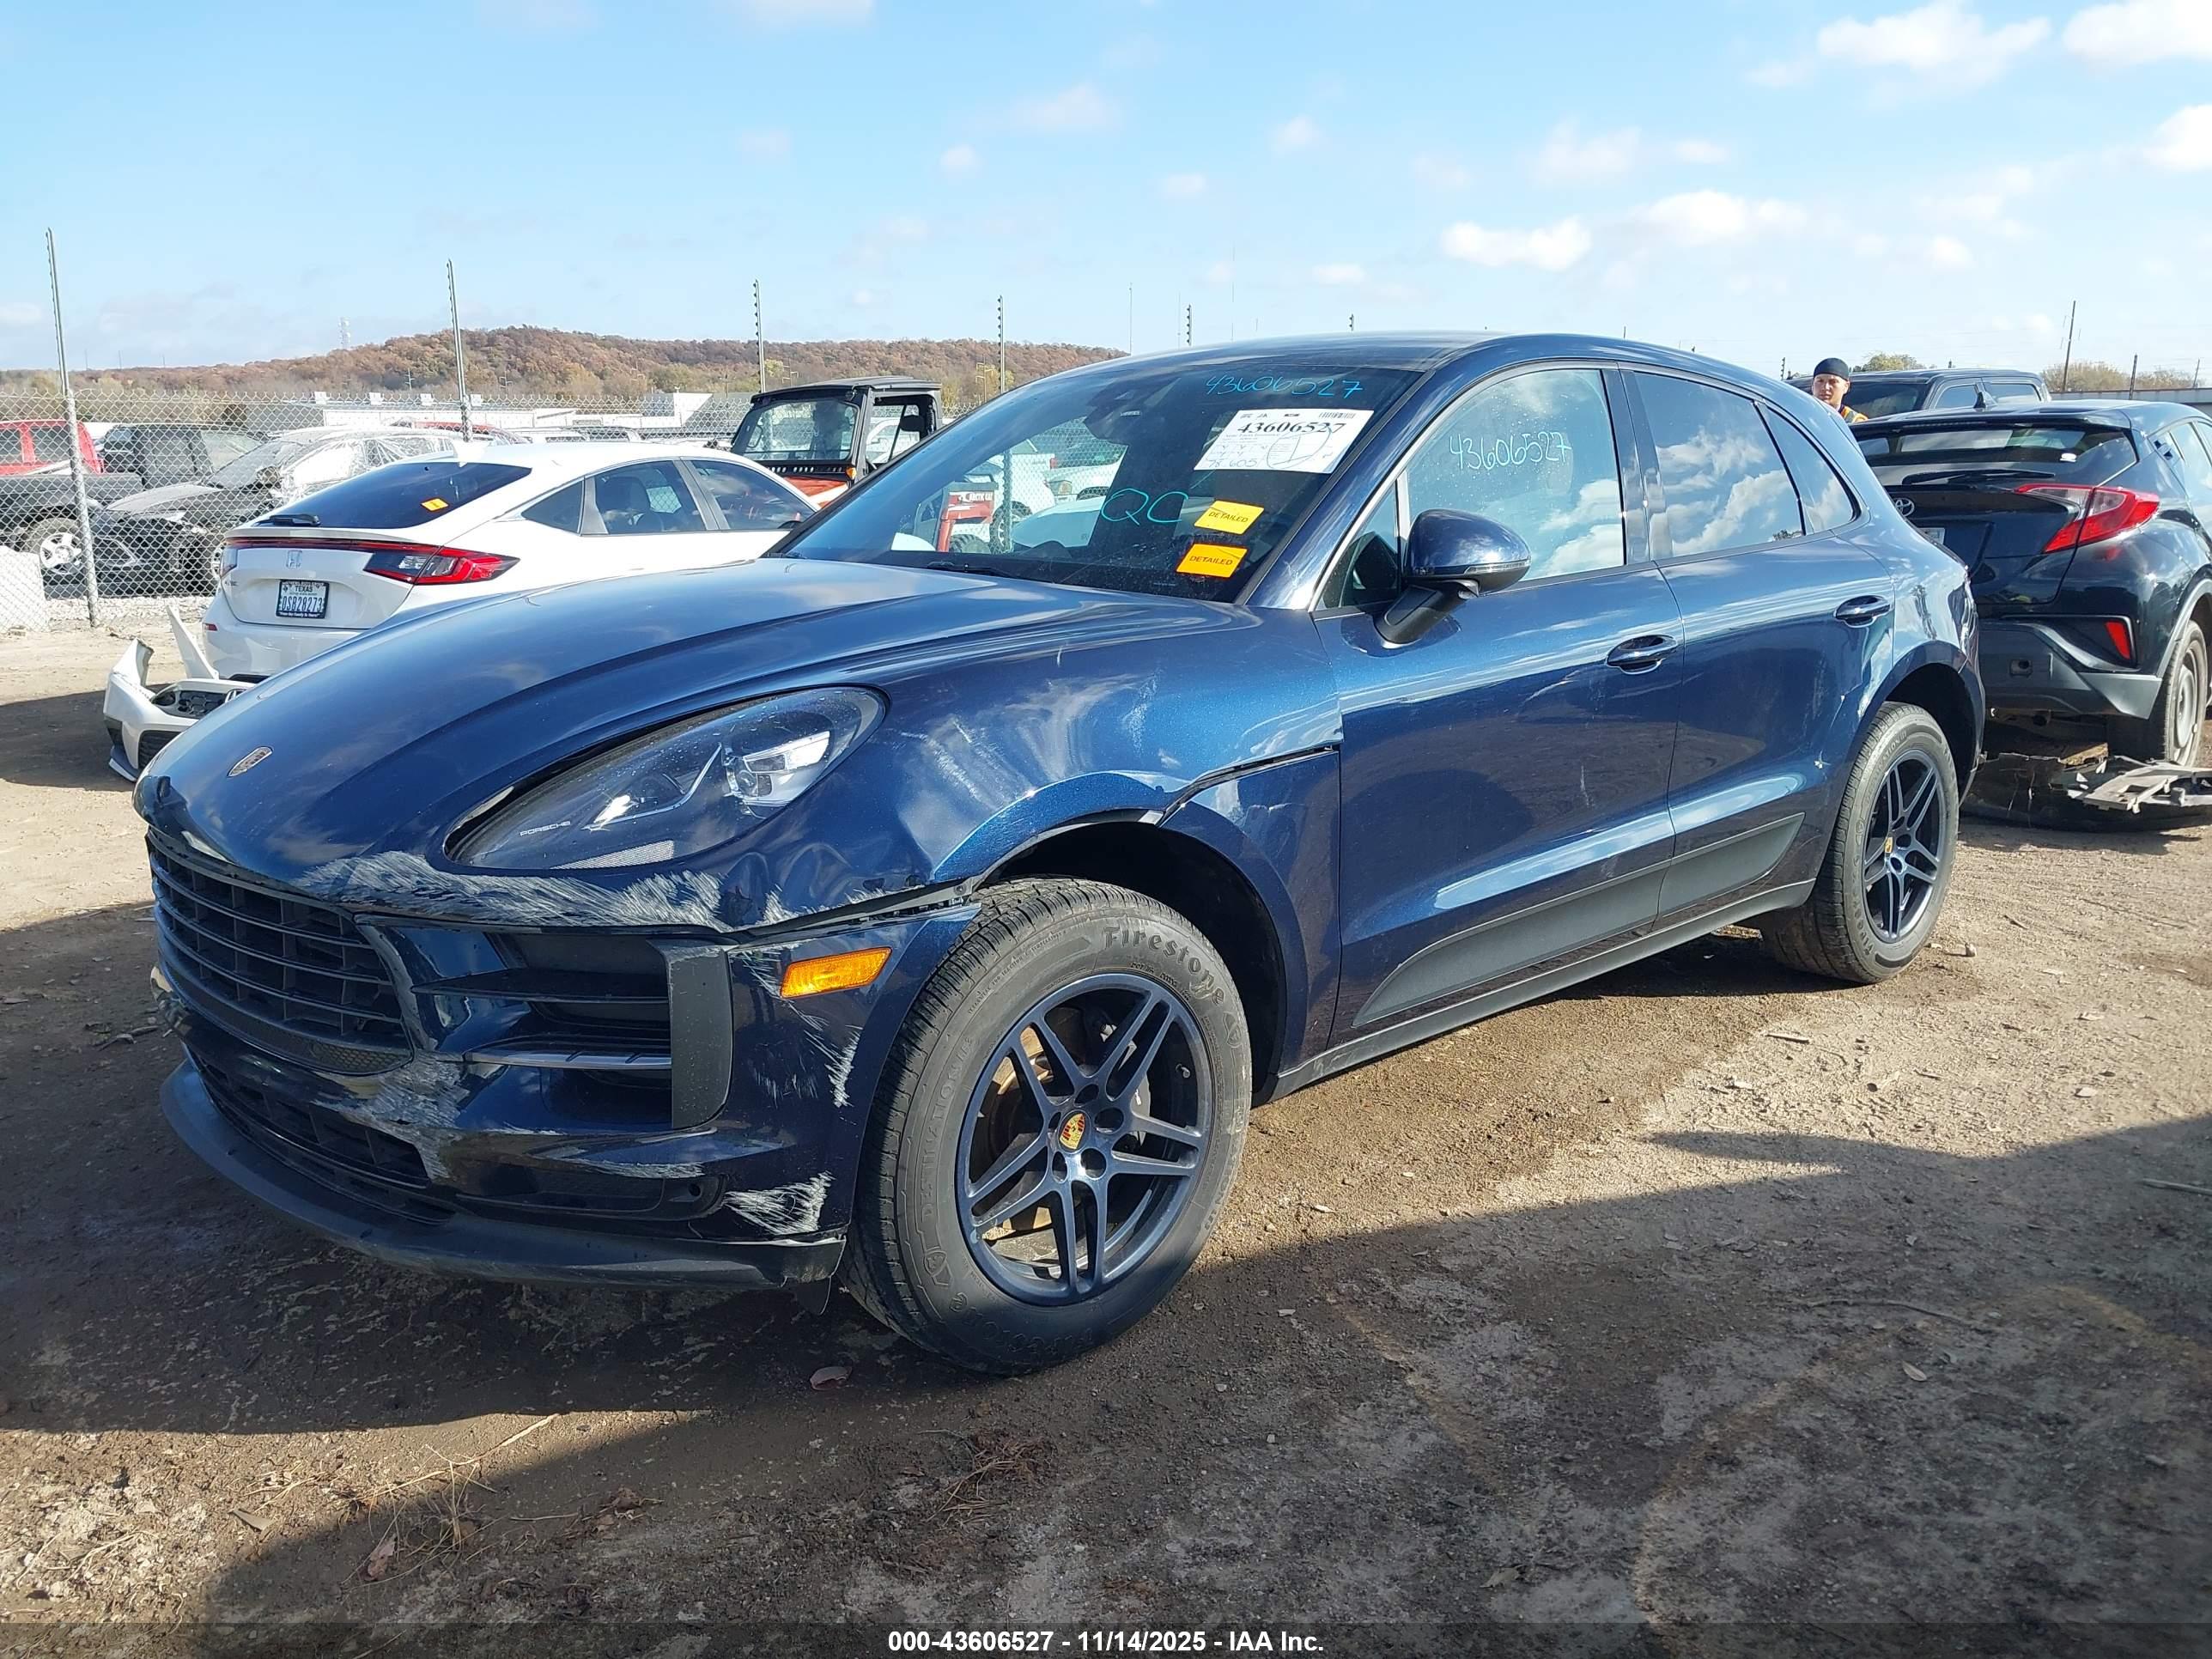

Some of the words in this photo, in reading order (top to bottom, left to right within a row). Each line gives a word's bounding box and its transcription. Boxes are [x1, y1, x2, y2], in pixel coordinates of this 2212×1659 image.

[1206, 376, 1363, 398] 43606527
[1237, 422, 1346, 434] 43606527
[1449, 431, 1572, 471] 43606527
[1101, 488, 1189, 526] QC
[1208, 511, 1249, 523] DETAILED
[1189, 555, 1232, 566] DETAILED
[520, 821, 570, 836] PORSCHE
[1103, 927, 1224, 1006] Firestone
